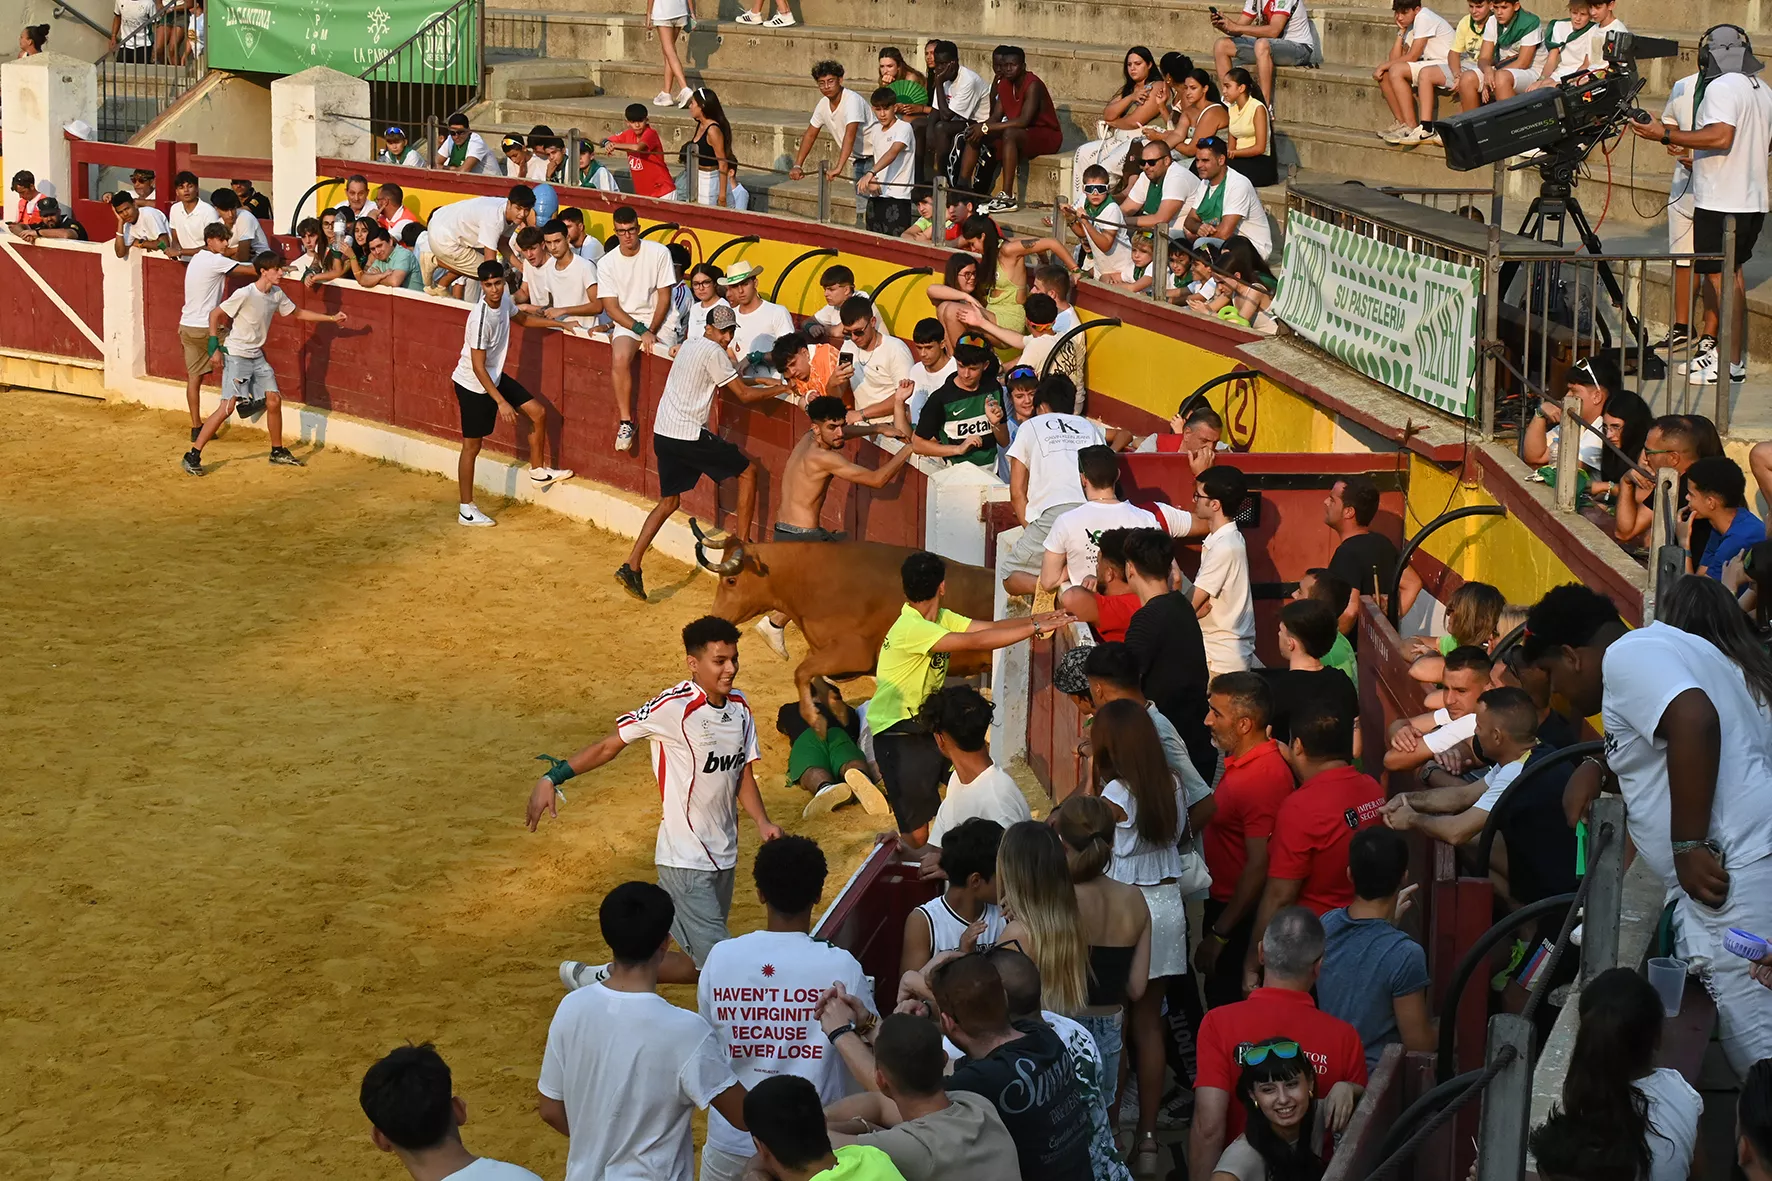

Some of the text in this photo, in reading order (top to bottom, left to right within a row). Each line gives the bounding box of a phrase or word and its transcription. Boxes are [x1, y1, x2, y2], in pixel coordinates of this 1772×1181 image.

[354, 47, 365, 63] LA
[1334, 284, 1406, 332] SU PASTELERÍA
[1234, 379, 1248, 435] 2
[714, 988, 780, 1002] HAVEN'T
[717, 1008, 737, 1021] MY
[778, 1045, 823, 1059] LOSE
